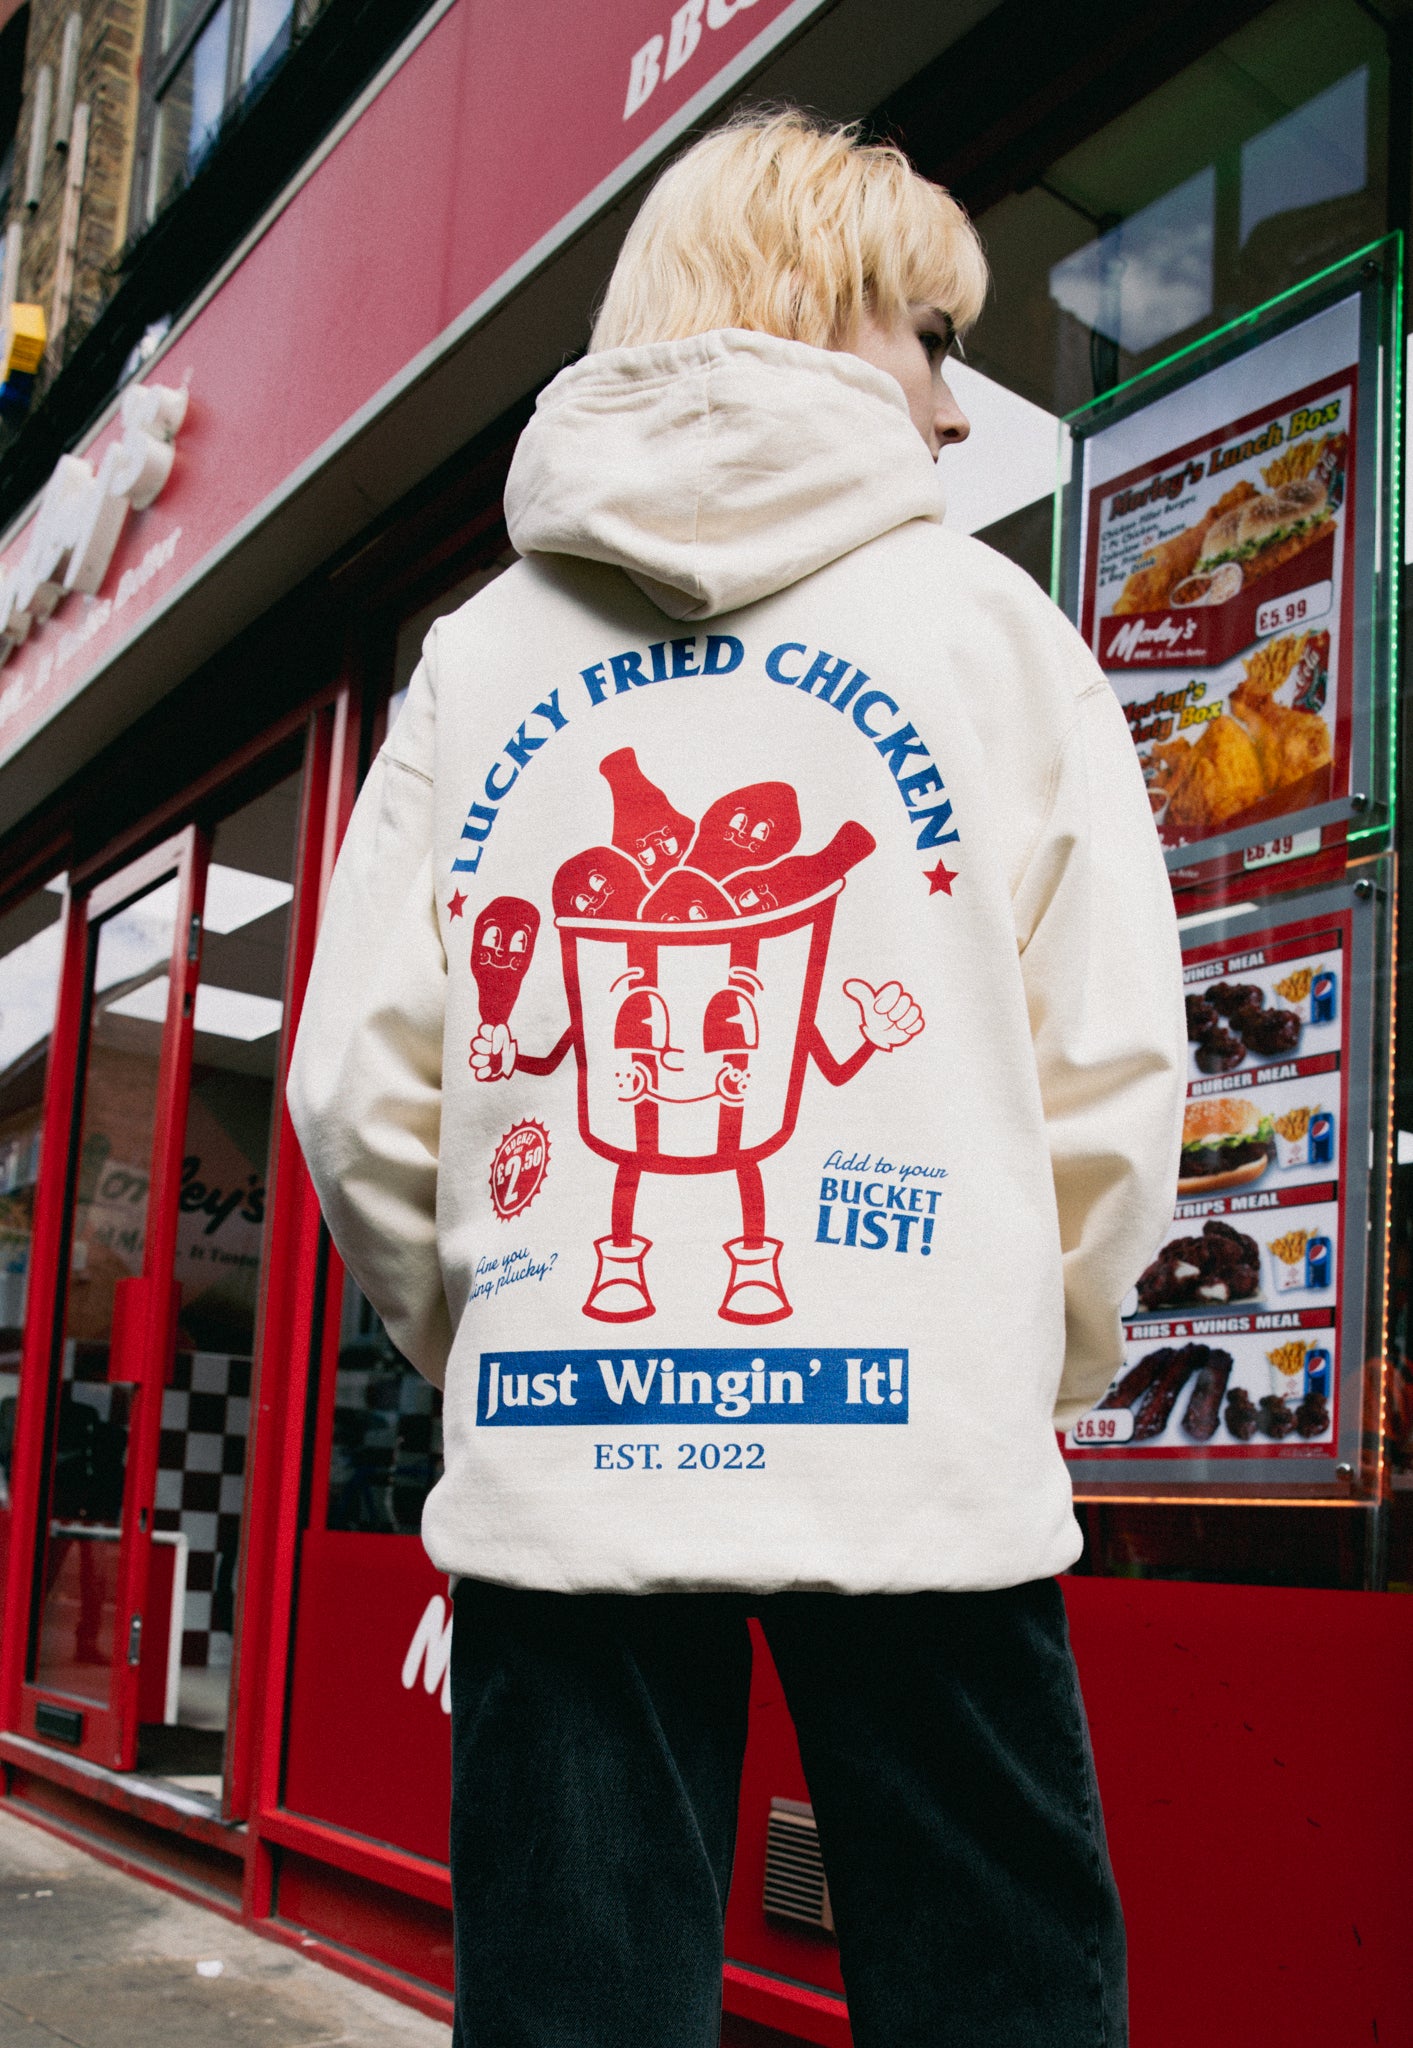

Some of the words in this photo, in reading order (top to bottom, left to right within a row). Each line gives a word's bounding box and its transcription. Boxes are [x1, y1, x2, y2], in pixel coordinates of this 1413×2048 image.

[1207, 422, 1283, 477] Lunch
[1287, 399, 1341, 441] Box
[1259, 599, 1307, 631] £5.99
[1177, 700, 1223, 731] Box
[451, 688, 570, 875] LUCKY
[579, 635, 745, 707] FRIED
[765, 642, 960, 851] CHICKEN
[1228, 950, 1265, 973] MEAL
[1191, 1073, 1253, 1096] BURGER
[1256, 1063, 1299, 1084] MEAL
[505, 1132, 536, 1156] BUCKET
[823, 1150, 872, 1172] Add
[874, 1157, 896, 1174] to
[899, 1165, 949, 1182] your
[819, 1177, 942, 1214] BUCKET
[1173, 1199, 1225, 1219] TRIPS
[1231, 1192, 1280, 1211] MEAL
[815, 1205, 935, 1256] LIST!
[495, 1252, 558, 1295] plucky?
[502, 1248, 530, 1273] you
[1132, 1324, 1170, 1340] RIBS
[1174, 1323, 1188, 1337] &
[1191, 1317, 1251, 1335] WINGS
[1255, 1312, 1302, 1330] MEAL
[485, 1362, 579, 1420] Just
[597, 1358, 821, 1418] Wingin'
[845, 1358, 904, 1406] It!
[1077, 1420, 1116, 1438] £6.99
[594, 1444, 663, 1470] EST.
[677, 1444, 766, 1470] 2022
